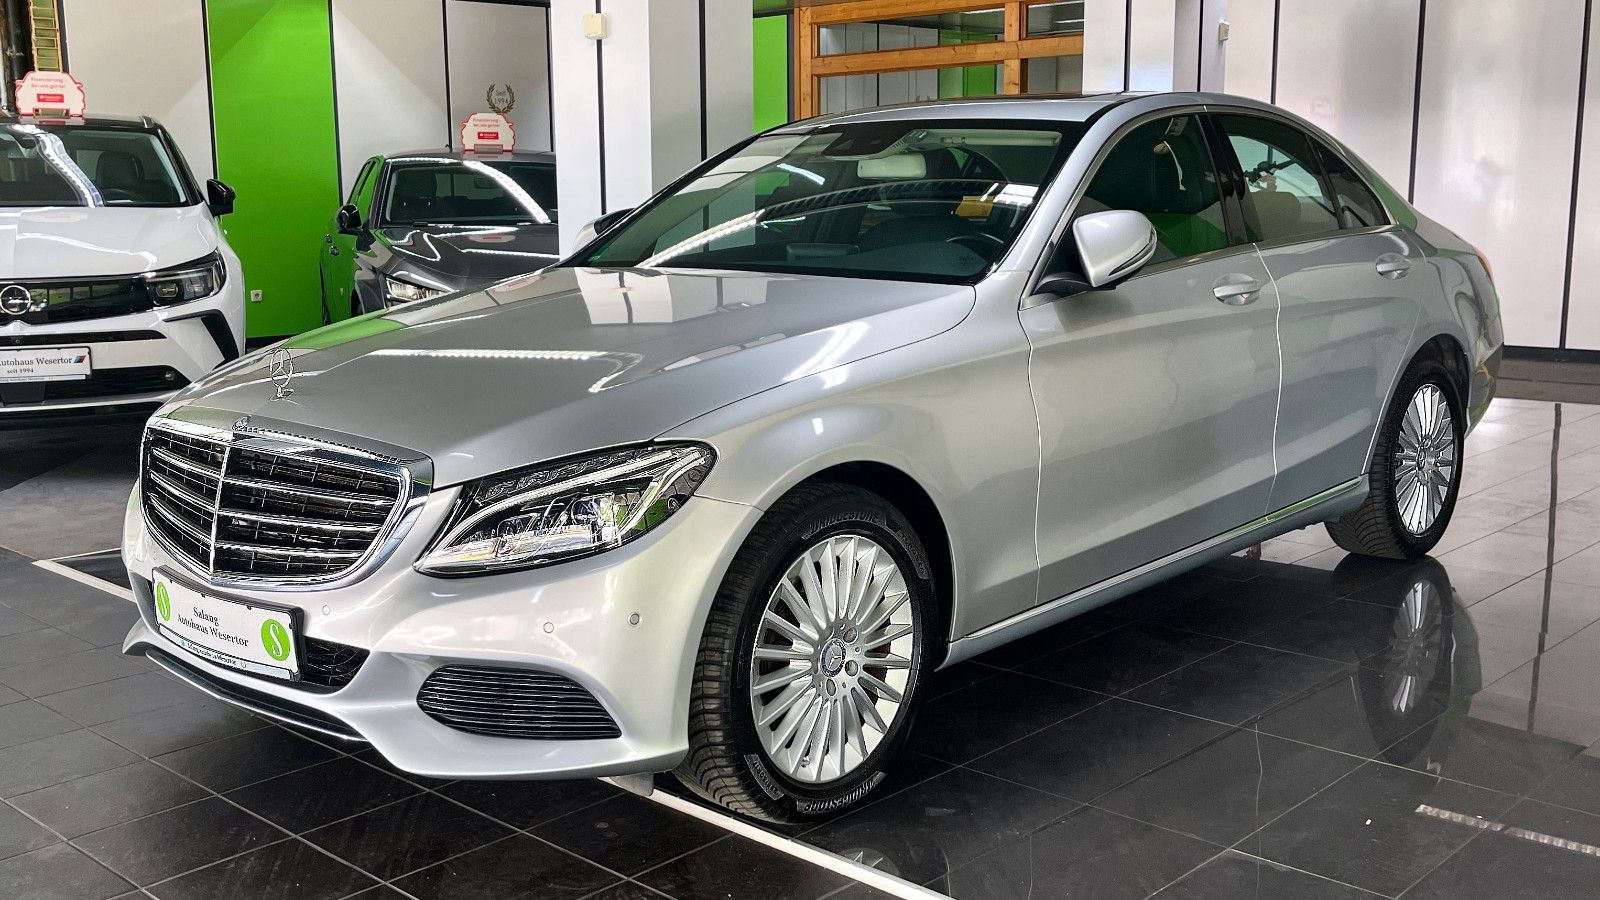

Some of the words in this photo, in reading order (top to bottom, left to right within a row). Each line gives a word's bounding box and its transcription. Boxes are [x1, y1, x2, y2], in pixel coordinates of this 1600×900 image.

[0, 358, 34, 366] utohaus
[36, 357, 72, 365] Wesertor
[193, 606, 220, 627] Salang
[177, 613, 209, 636] Autohaus
[209, 625, 249, 647] Wesertor
